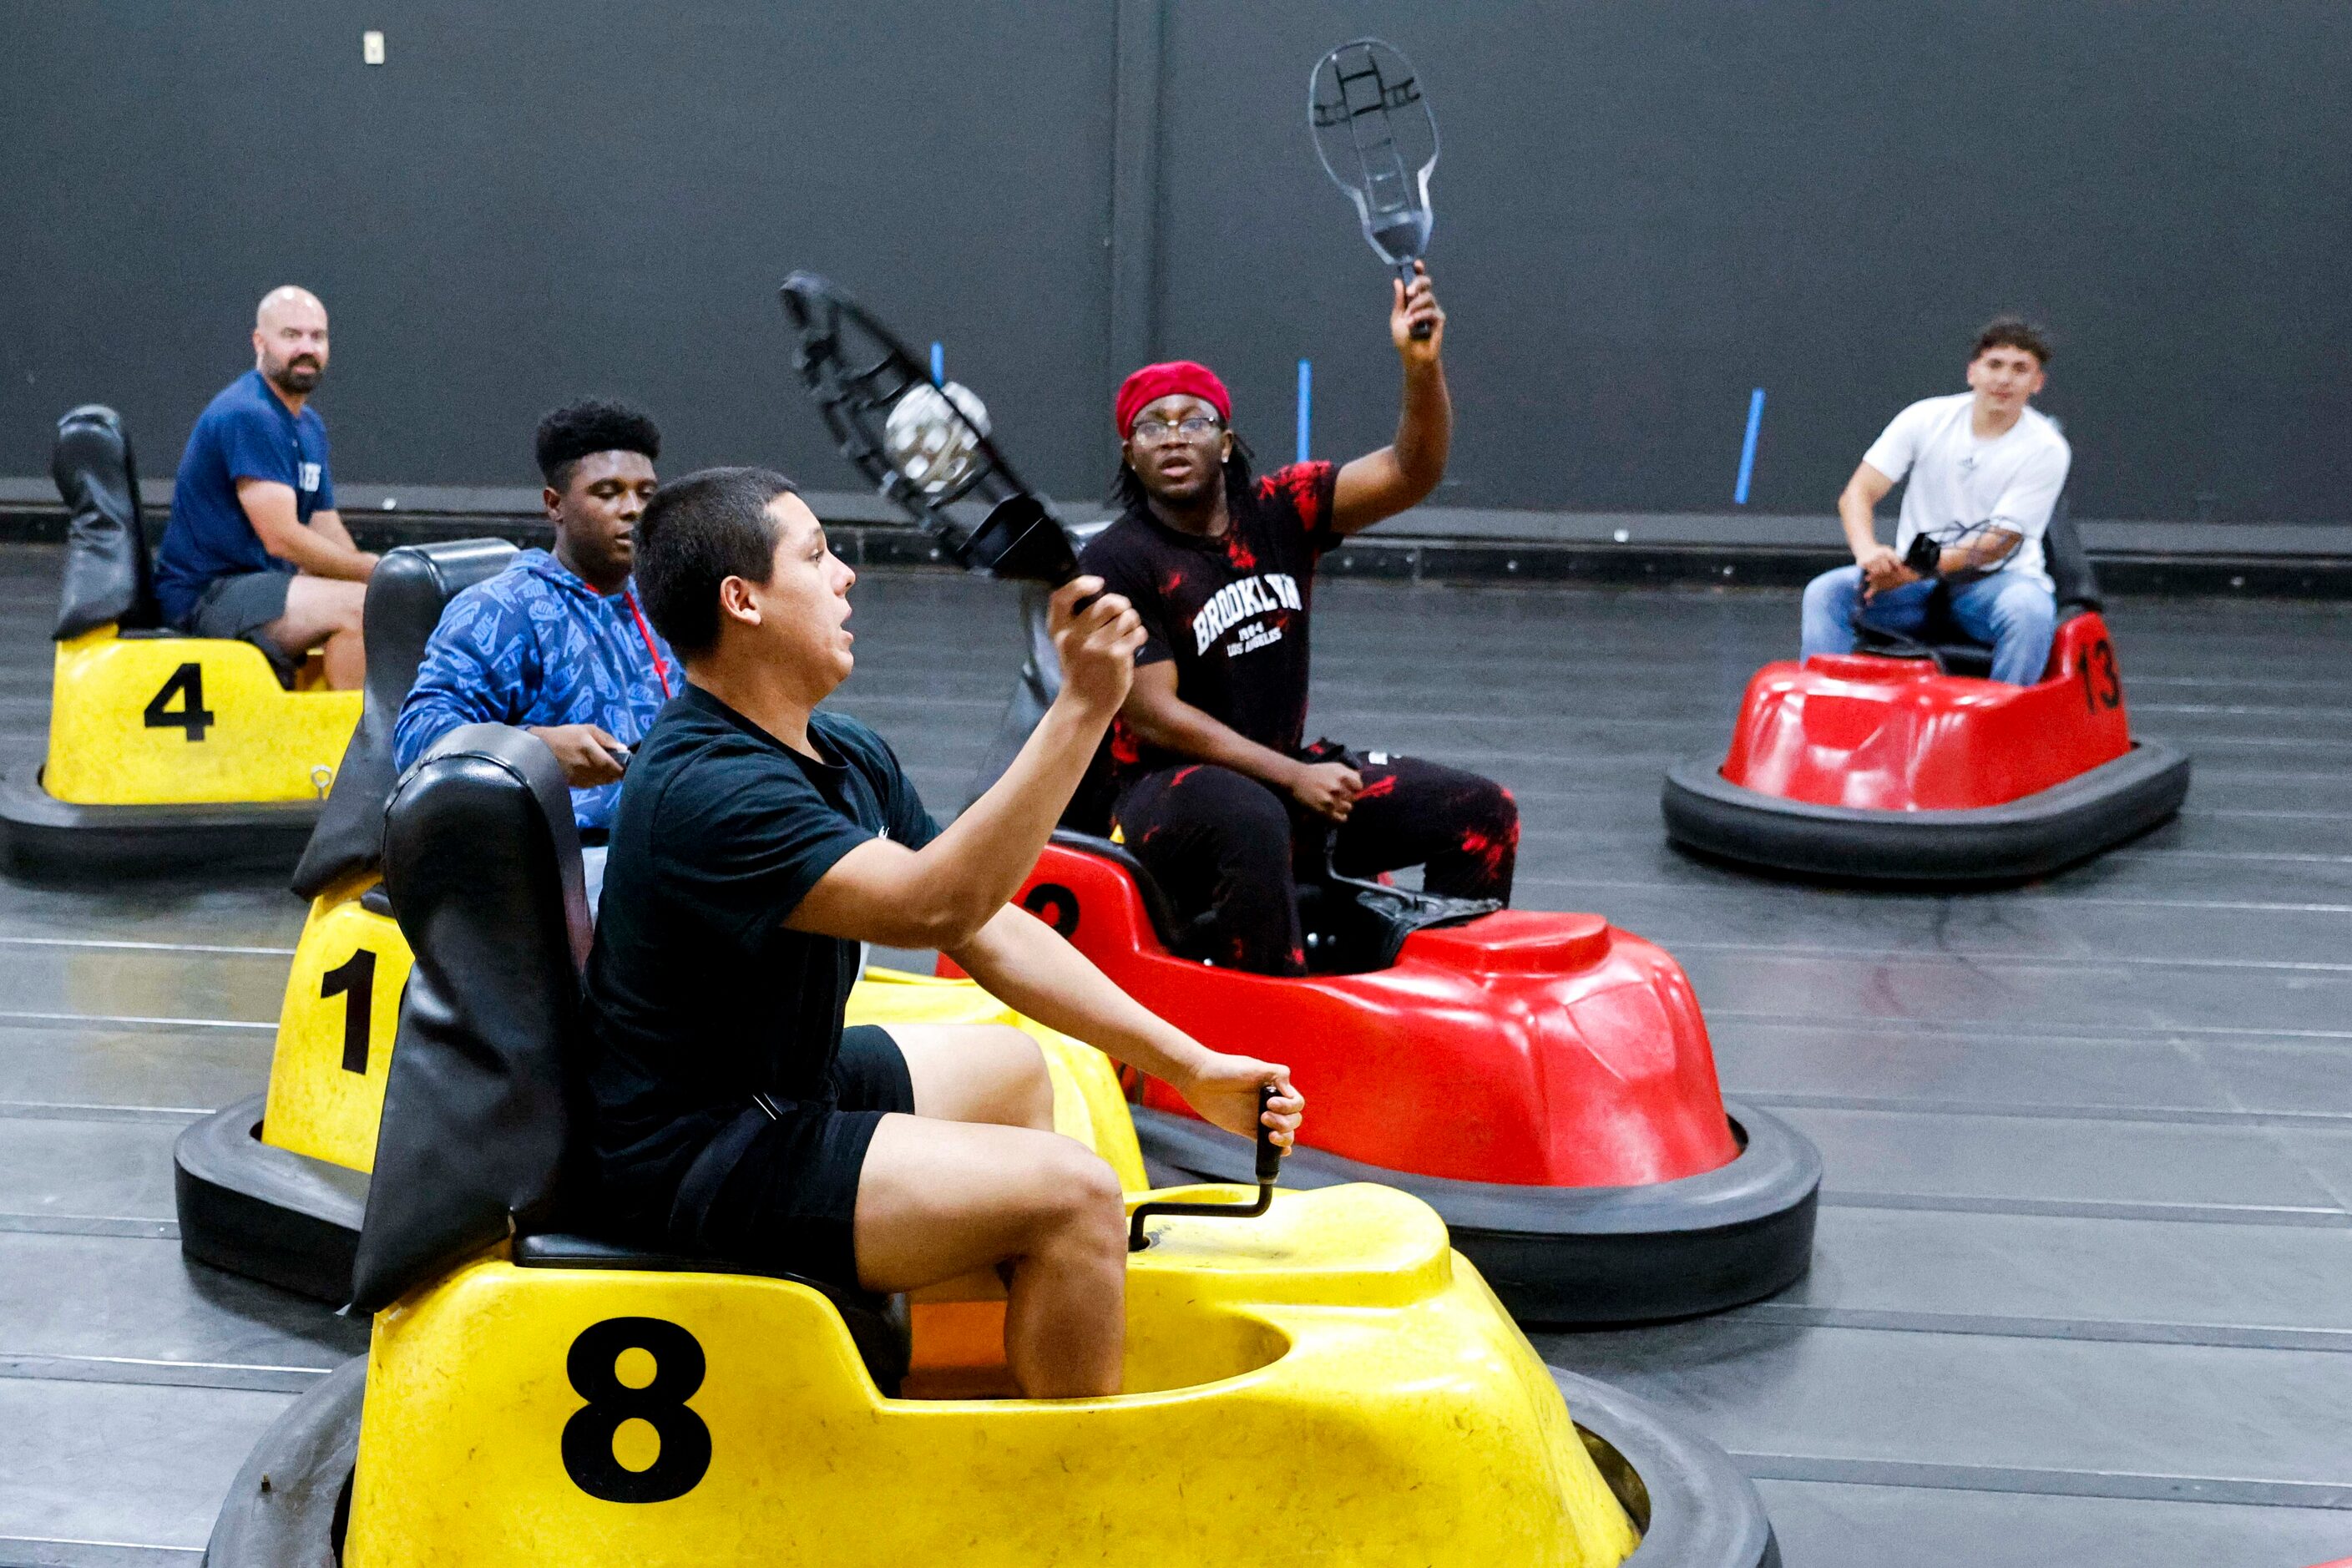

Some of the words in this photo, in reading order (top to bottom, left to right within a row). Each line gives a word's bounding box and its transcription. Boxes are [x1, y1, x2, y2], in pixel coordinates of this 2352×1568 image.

[1192, 573, 1302, 656] BROOKLYN
[144, 663, 215, 741] 4
[2077, 640, 2121, 716] 13
[321, 948, 377, 1075] 1
[561, 1316, 712, 1504] 8
